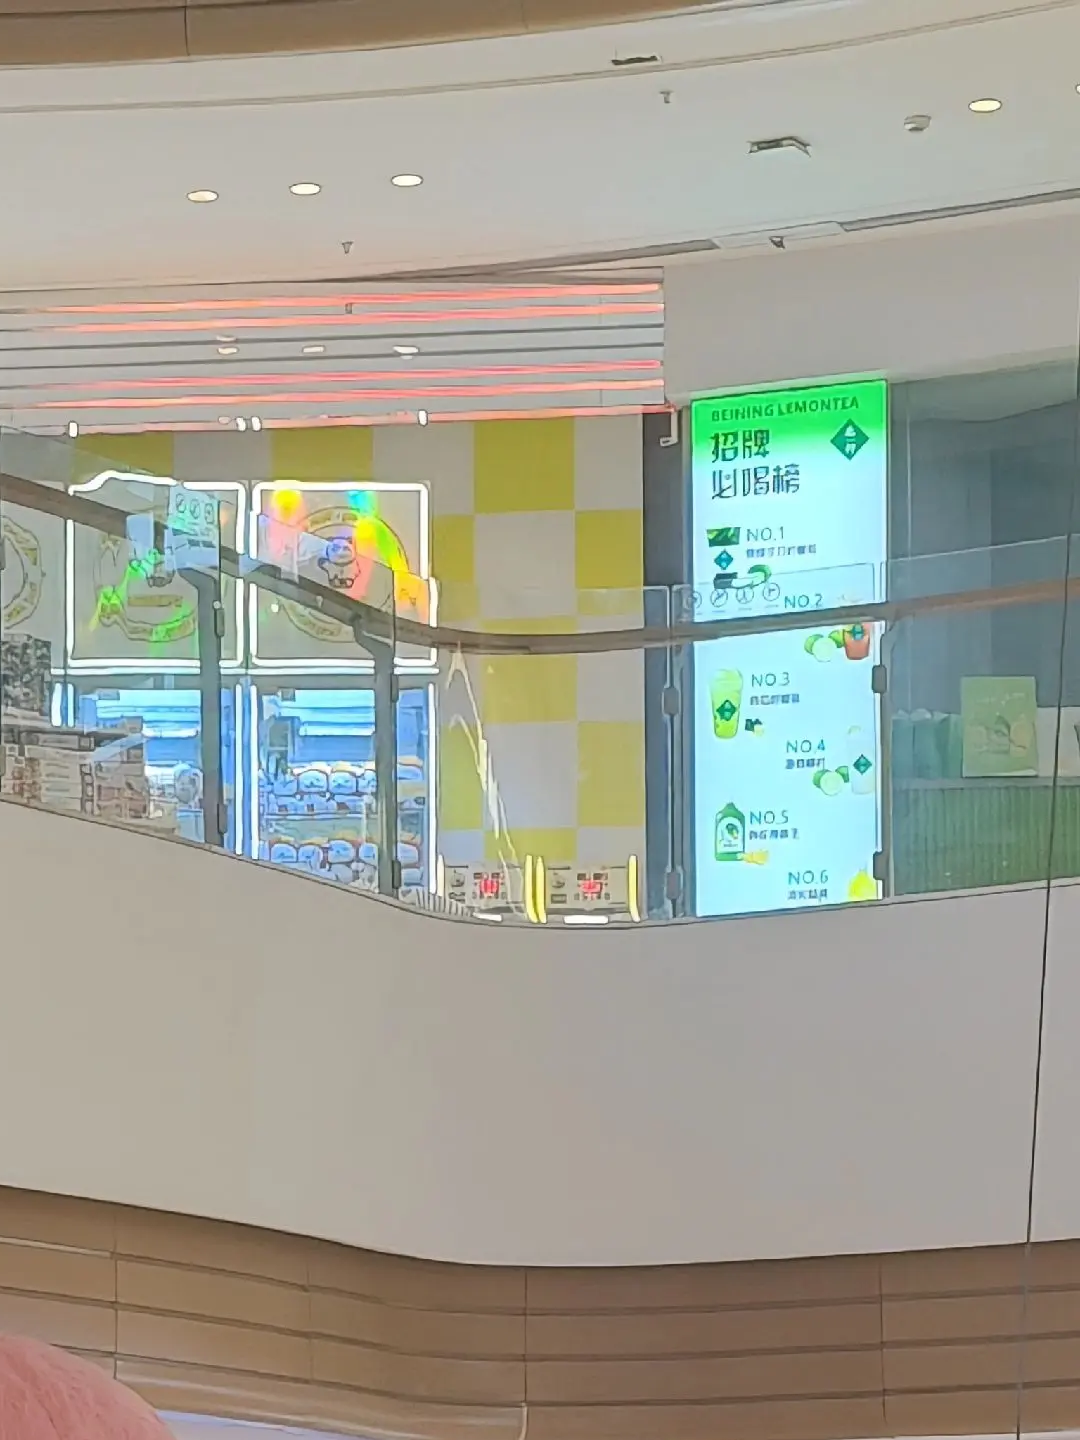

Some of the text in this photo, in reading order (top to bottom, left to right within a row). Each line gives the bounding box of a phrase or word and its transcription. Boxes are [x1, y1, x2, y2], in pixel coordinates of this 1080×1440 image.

[710, 429, 770, 463] 招牌
[711, 463, 800, 500] 必唱榜
[746, 526, 785, 542] NO.1
[784, 594, 824, 609] NO.2
[751, 671, 791, 688] NO.3
[786, 739, 826, 754] NO.4
[750, 810, 790, 825] NO.5
[788, 869, 829, 885] NO.6
